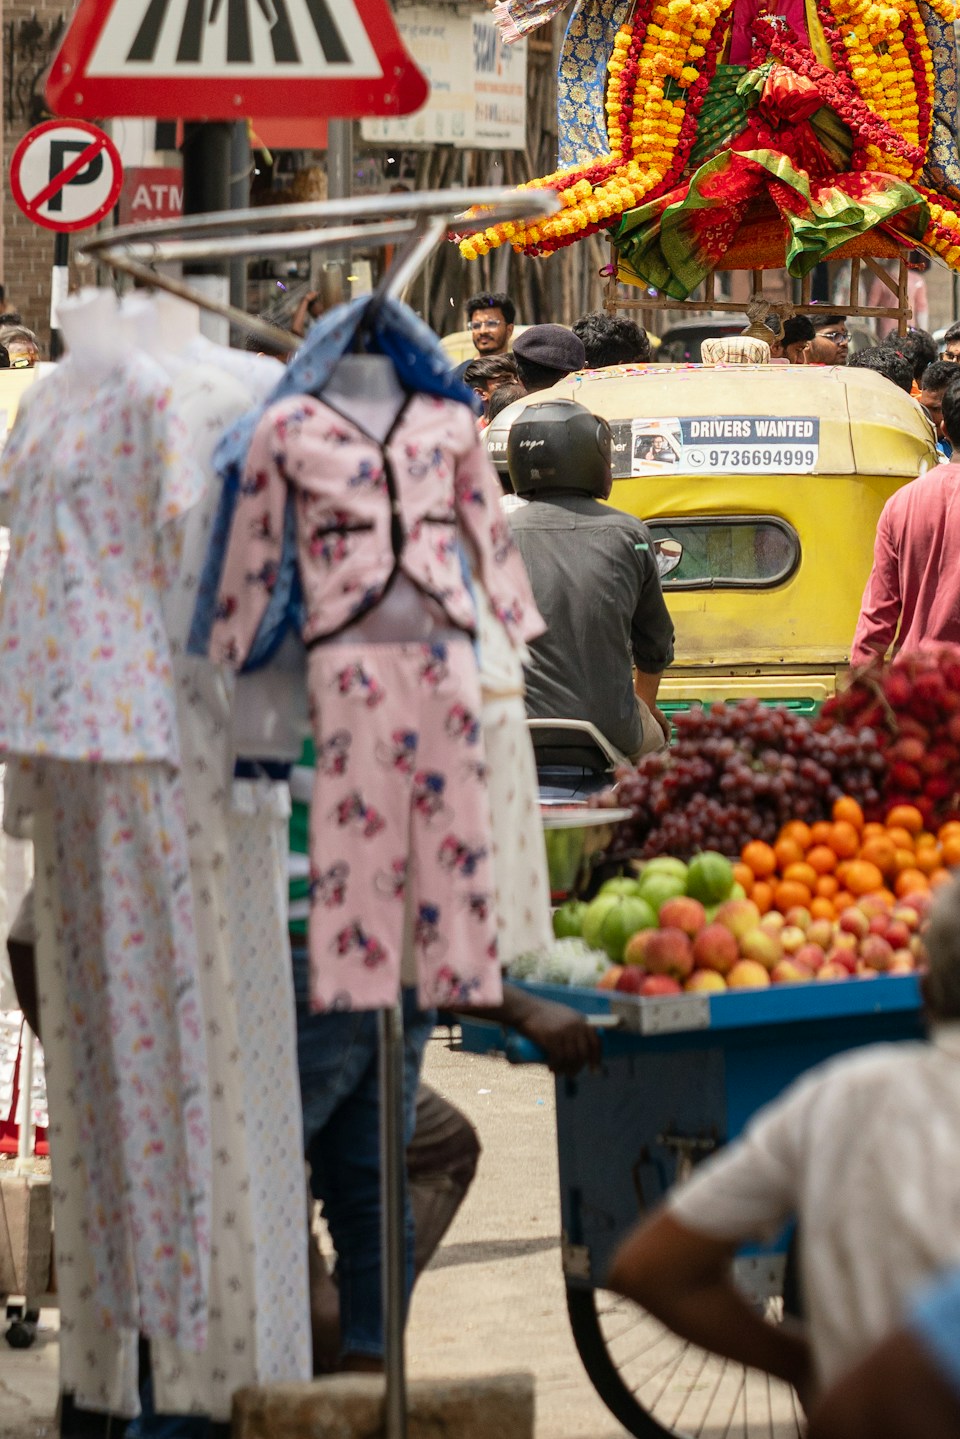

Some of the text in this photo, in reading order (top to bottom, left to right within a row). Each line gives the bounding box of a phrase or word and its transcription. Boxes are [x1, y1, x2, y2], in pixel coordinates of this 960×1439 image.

[131, 183, 184, 212] ATM
[690, 420, 814, 438] DRIVERS WANTED
[709, 449, 814, 466] 9736694999
